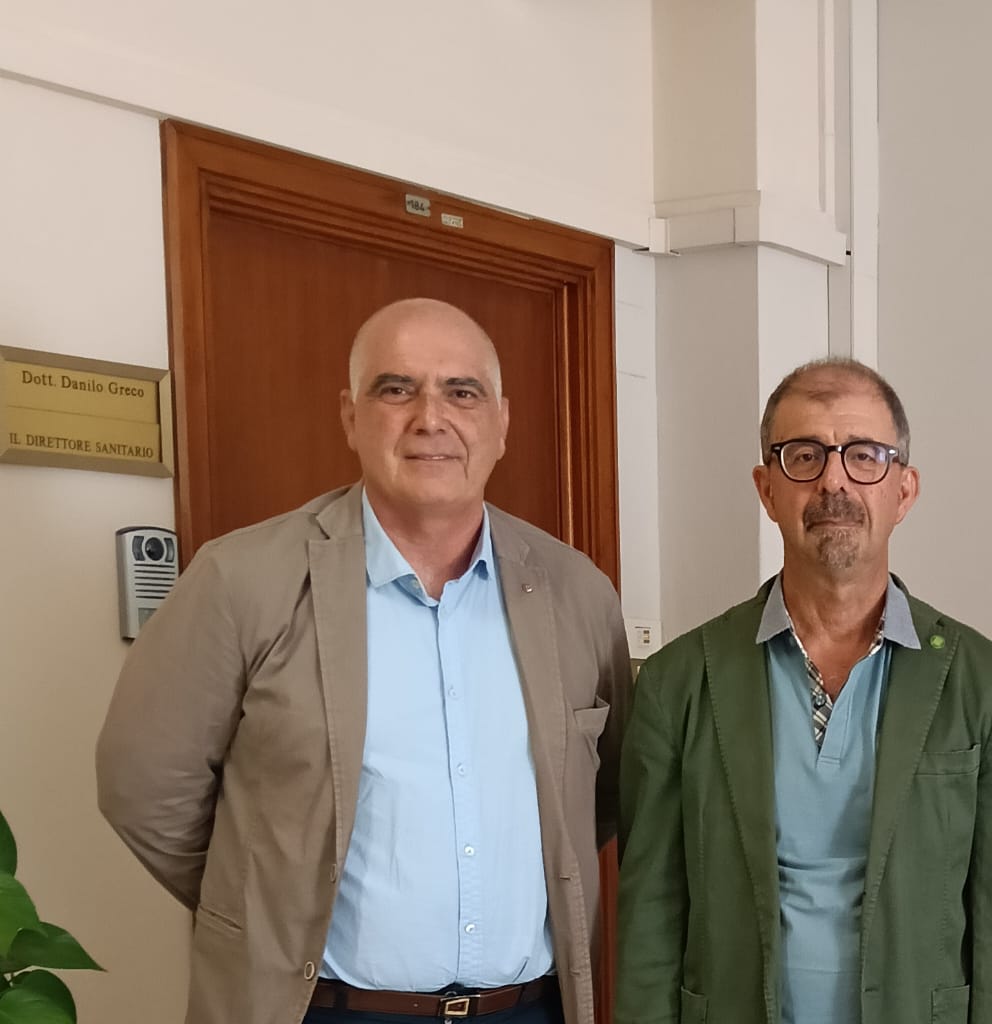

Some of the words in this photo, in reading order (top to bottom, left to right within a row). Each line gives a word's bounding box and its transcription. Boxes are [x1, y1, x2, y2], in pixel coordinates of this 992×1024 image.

[22, 370, 57, 387] Dott.
[61, 375, 103, 393] Danilo
[108, 382, 145, 398] Greco
[9, 432, 21, 445] IL
[26, 434, 91, 452] DIRETTORE
[95, 441, 154, 458] SANITARIO
